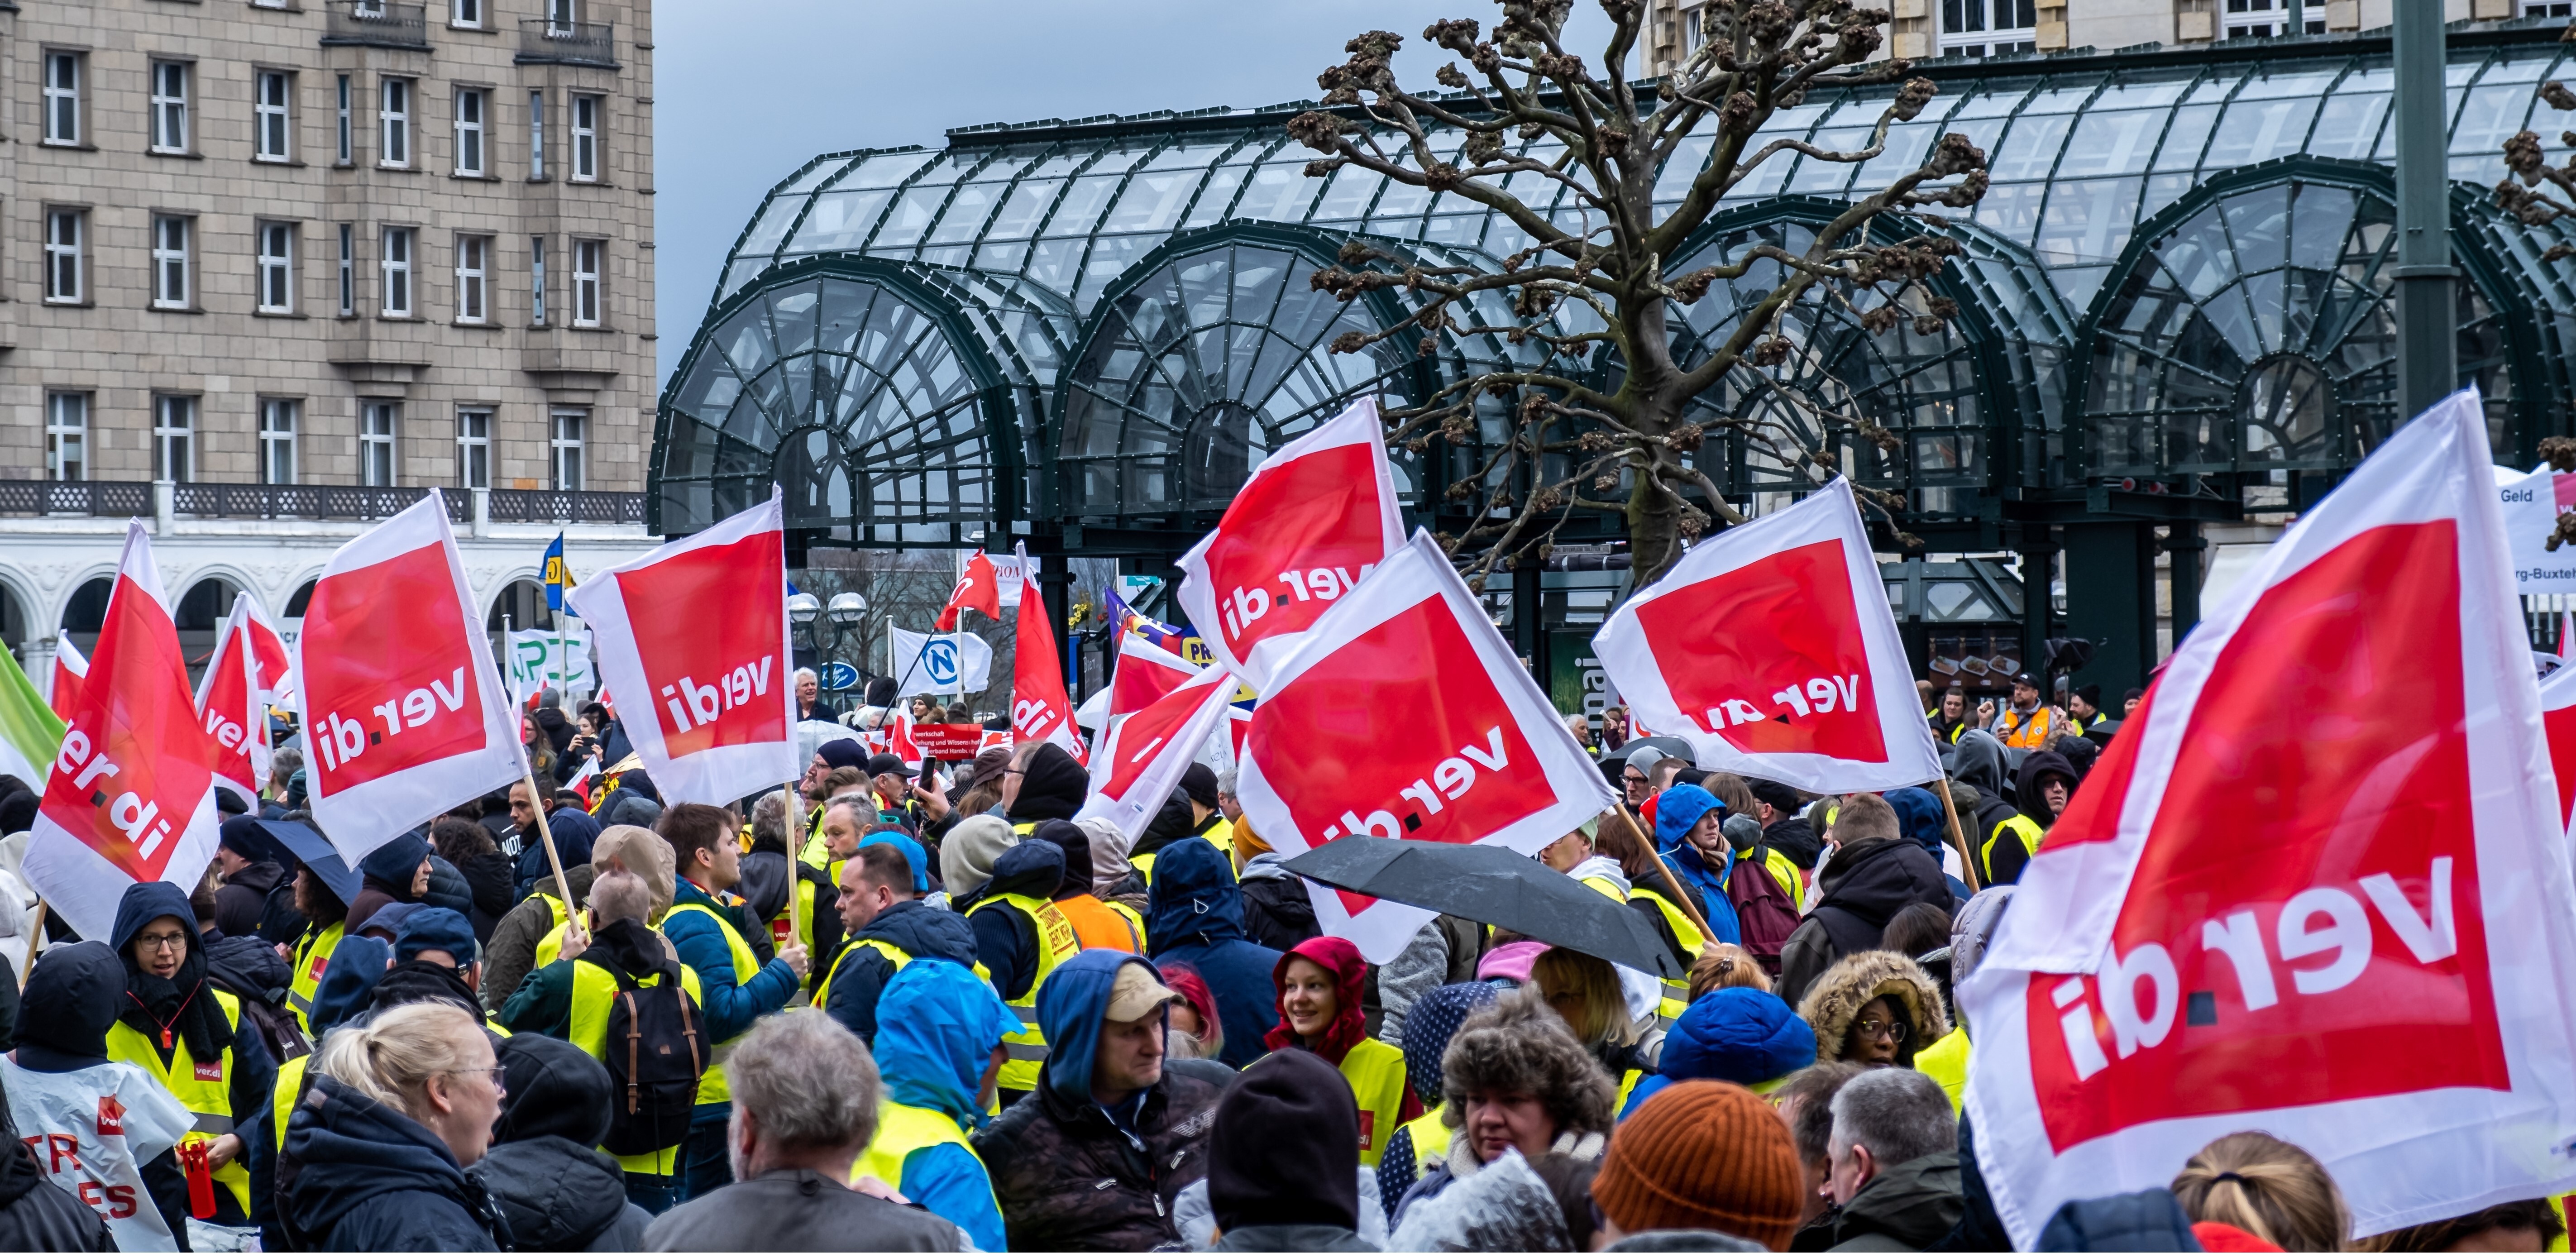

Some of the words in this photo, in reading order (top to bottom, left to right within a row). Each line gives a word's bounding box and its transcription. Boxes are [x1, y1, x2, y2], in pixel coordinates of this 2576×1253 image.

[2501, 489, 2533, 502] Geld
[1190, 643, 1218, 660] PR
[57, 718, 172, 861] er.di
[196, 1067, 221, 1078] ver.di
